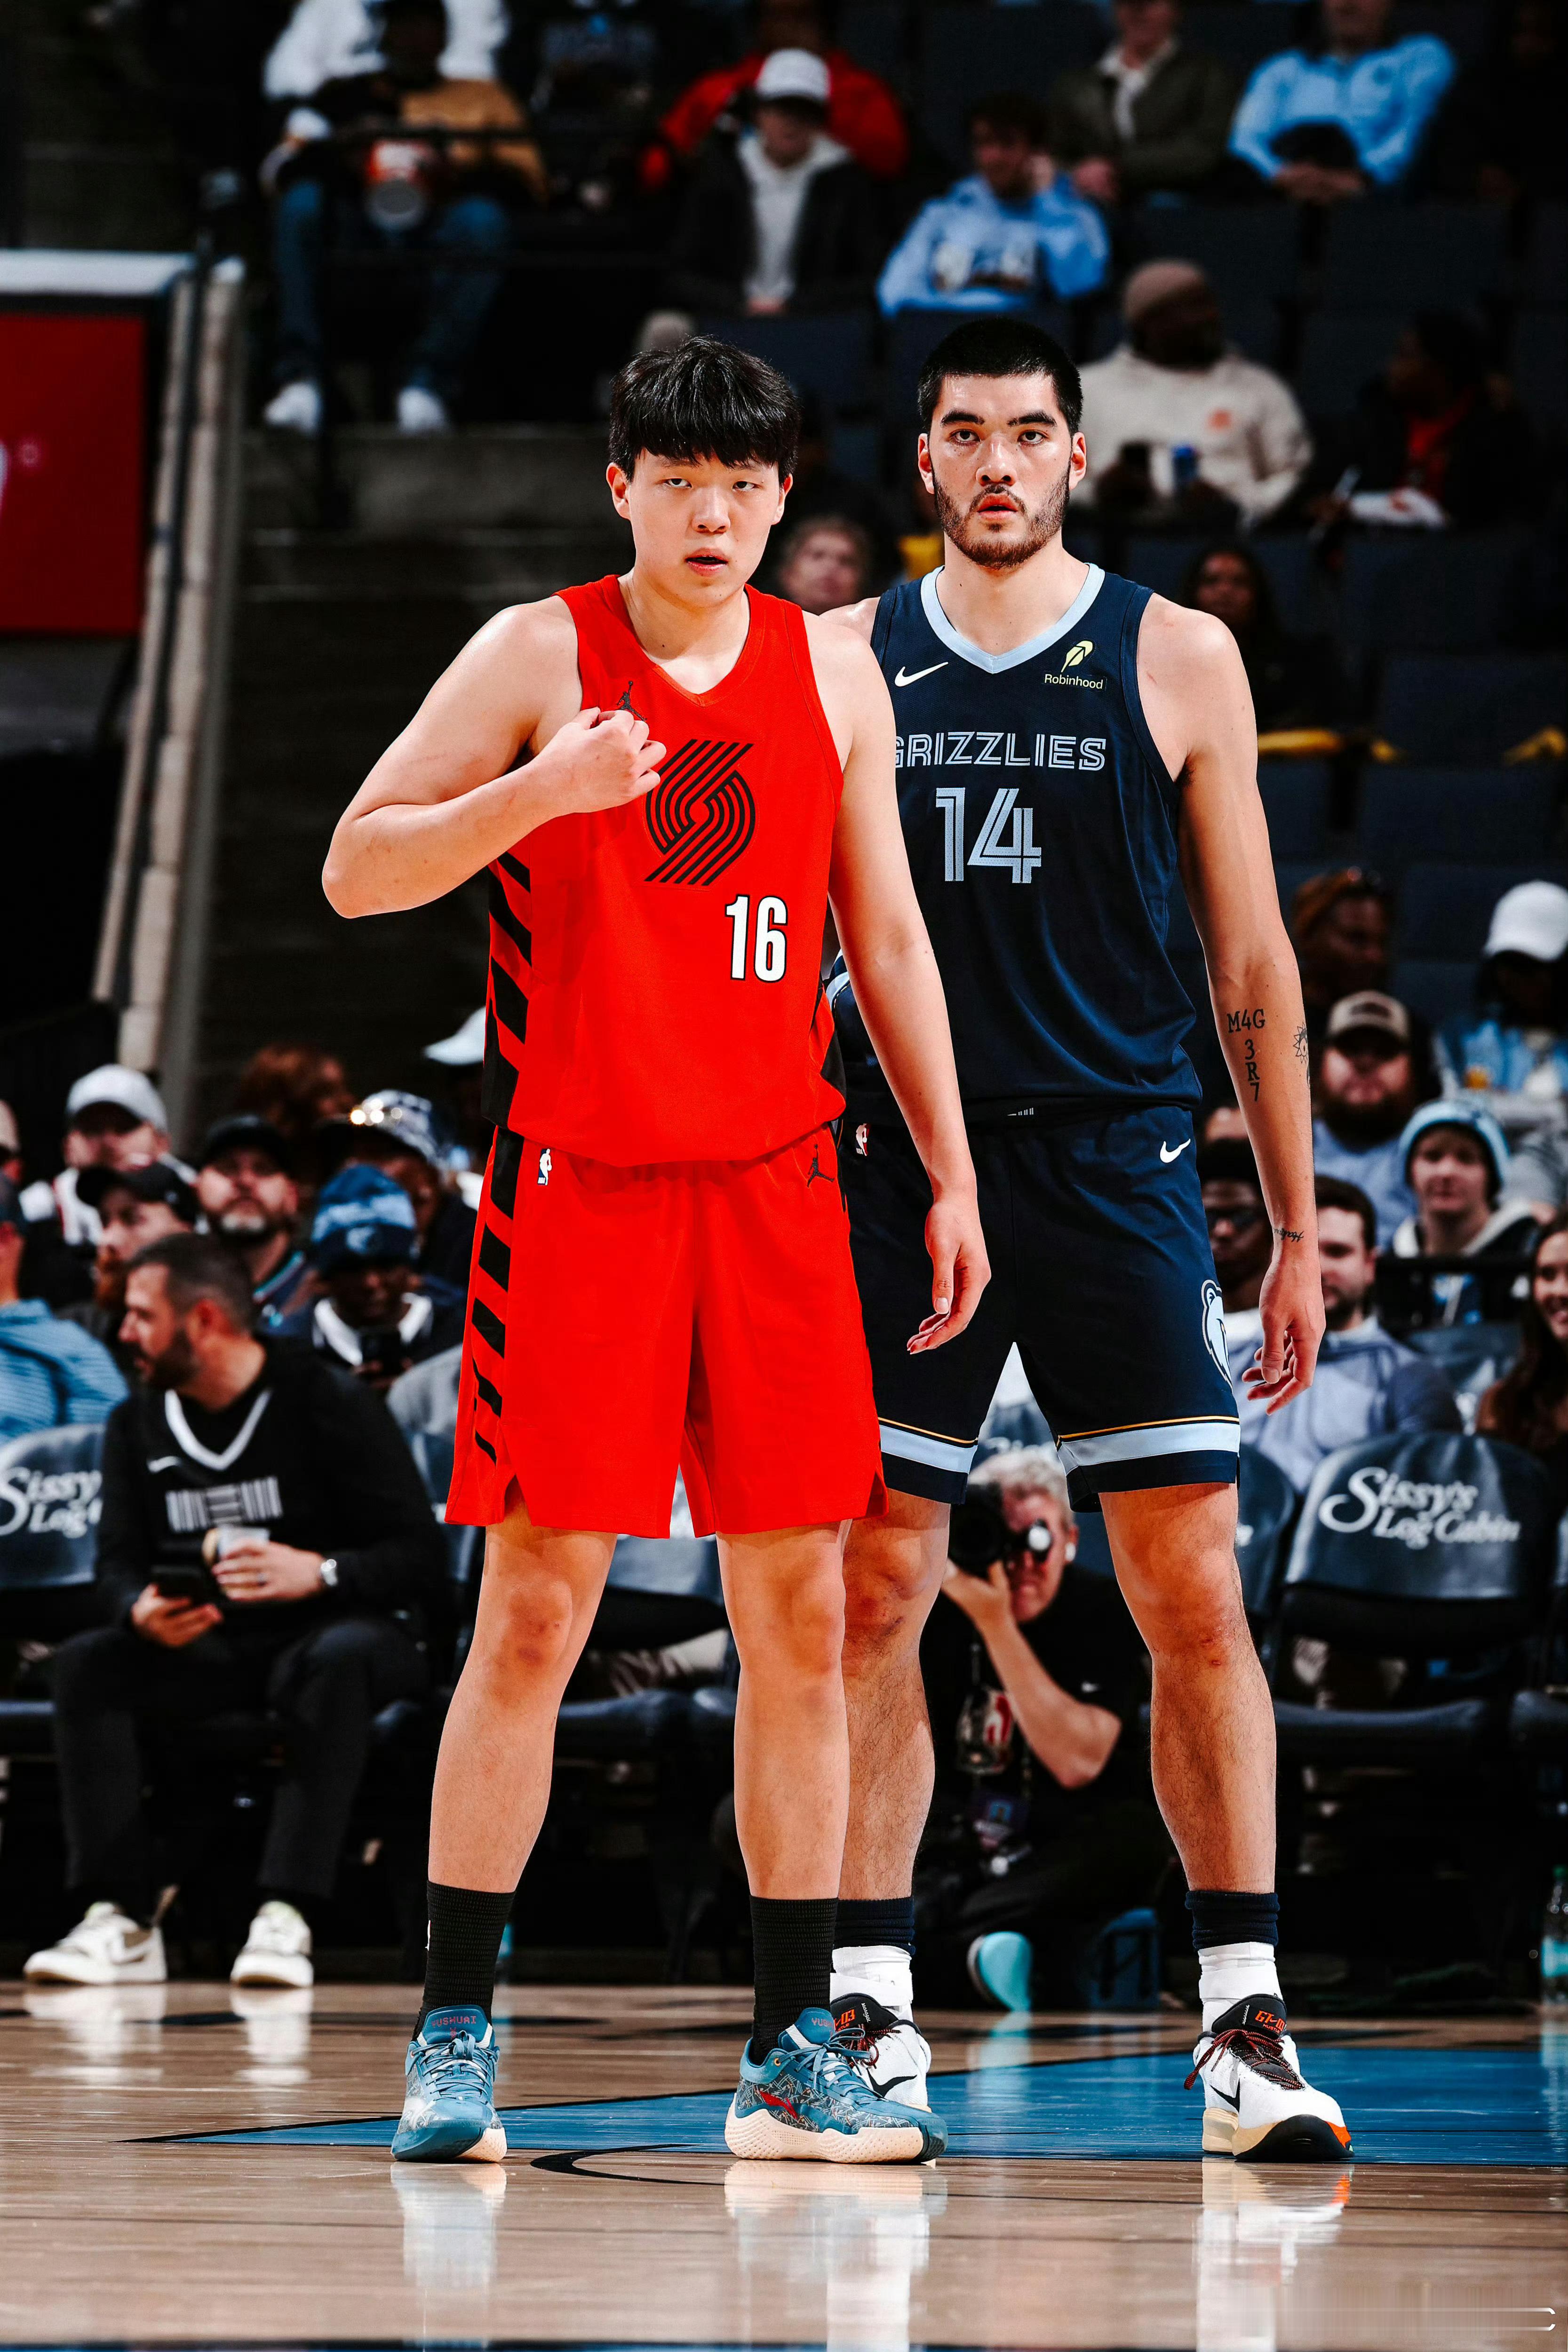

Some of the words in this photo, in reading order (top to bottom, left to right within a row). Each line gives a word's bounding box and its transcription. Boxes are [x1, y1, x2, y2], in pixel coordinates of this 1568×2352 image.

[1044, 674, 1103, 689] Robinhood
[936, 787, 1042, 883] 14
[725, 894, 788, 983] 16
[1226, 1009, 1266, 1033] M4G
[1318, 1466, 1479, 1533] Sissy's
[1373, 1508, 1433, 1549] Log
[1434, 1510, 1520, 1543] Cabin
[431, 2016, 476, 2028] YUSHUAI
